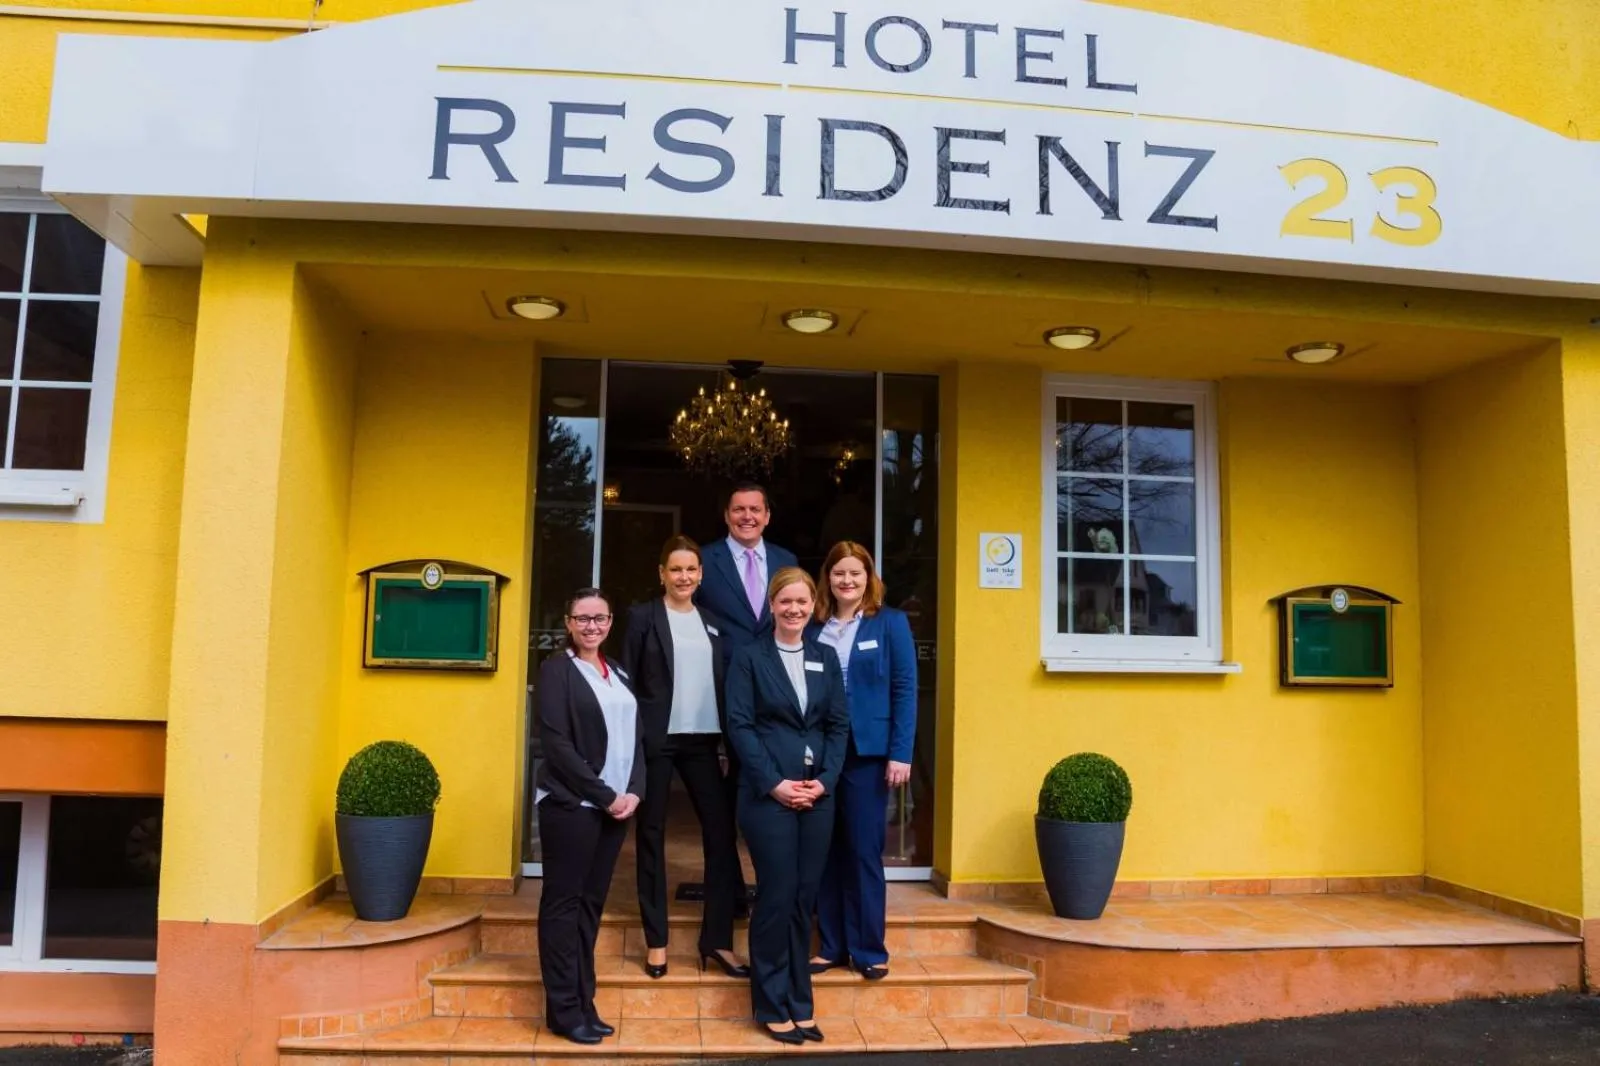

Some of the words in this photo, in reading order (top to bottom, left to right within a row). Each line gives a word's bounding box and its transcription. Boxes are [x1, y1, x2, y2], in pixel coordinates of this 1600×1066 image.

[783, 7, 1138, 95] HOTEL
[427, 96, 1219, 232] RESIDENZ
[1279, 158, 1443, 247] 23
